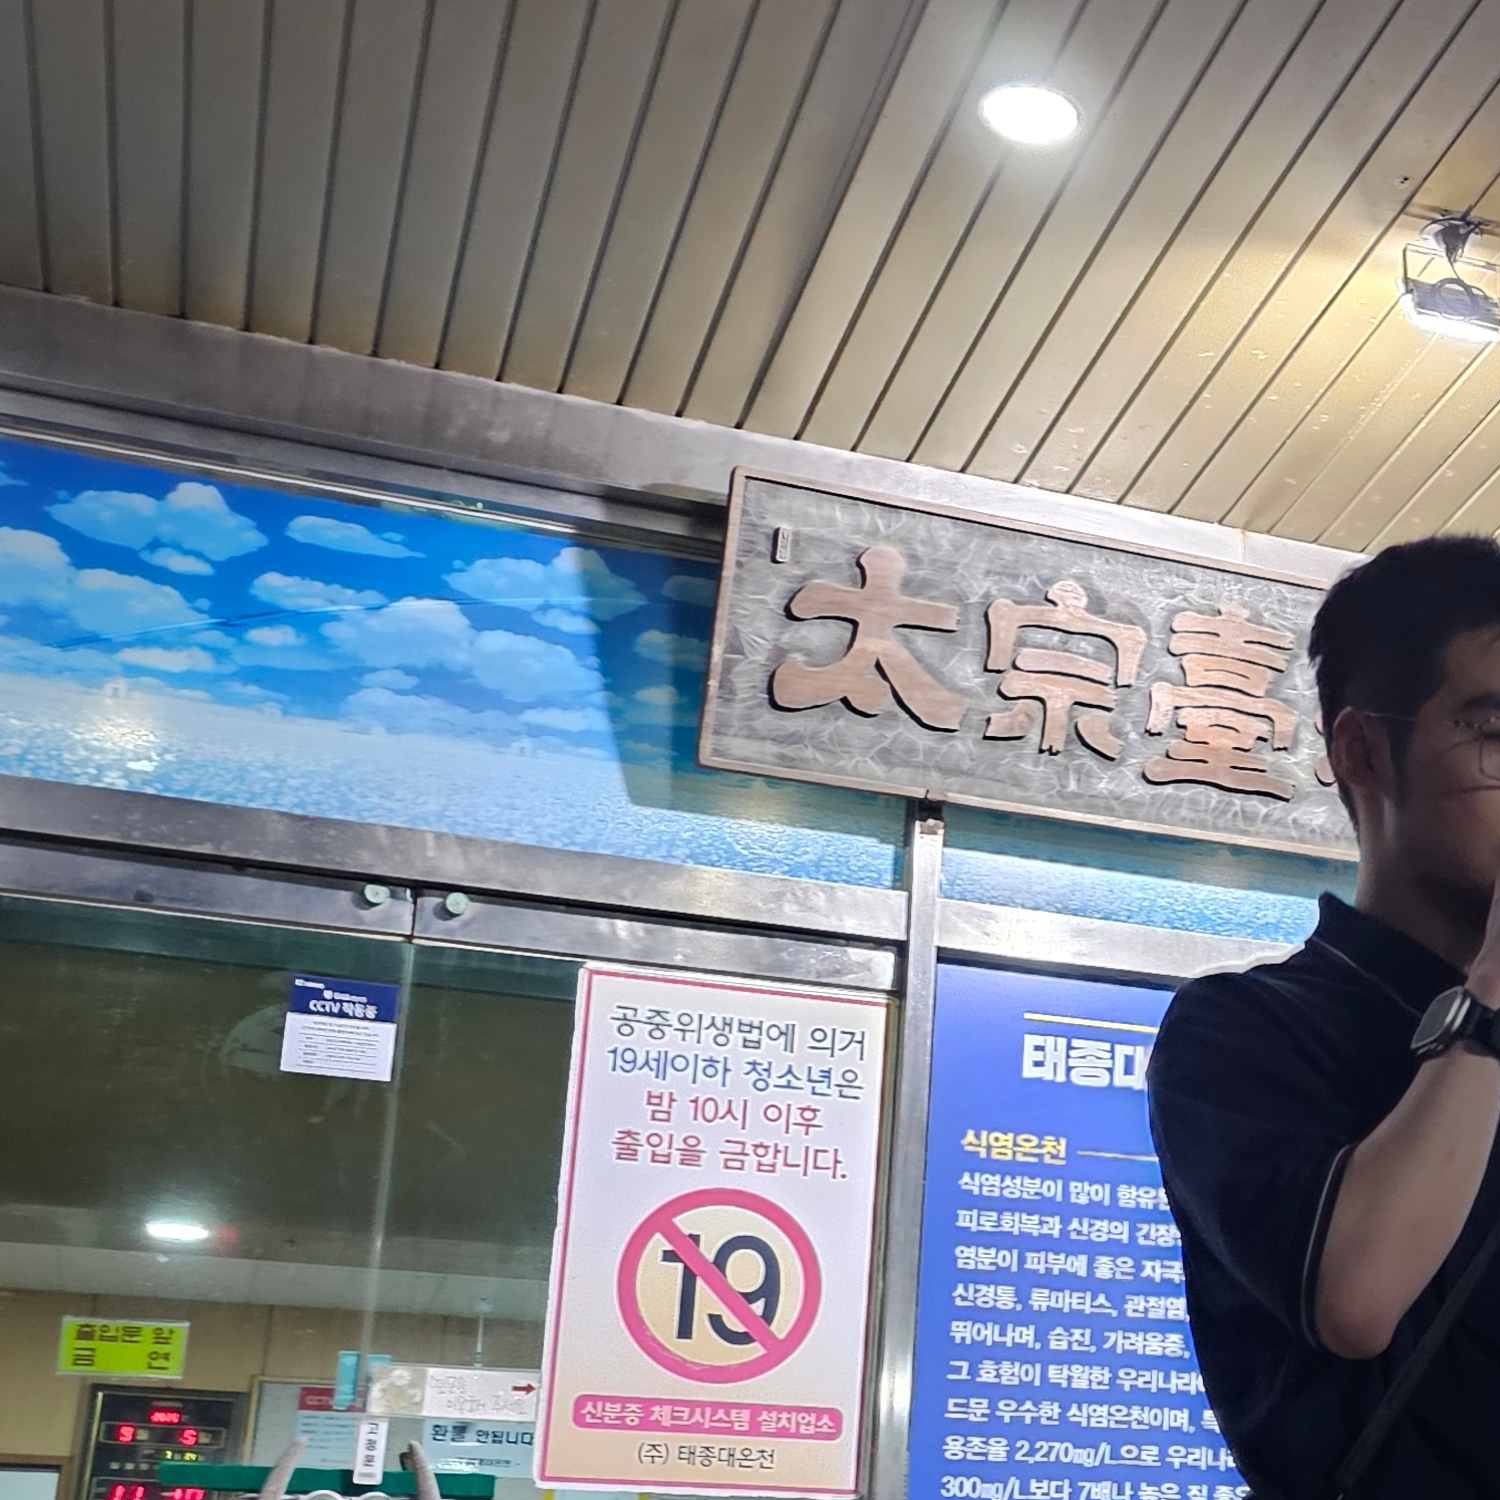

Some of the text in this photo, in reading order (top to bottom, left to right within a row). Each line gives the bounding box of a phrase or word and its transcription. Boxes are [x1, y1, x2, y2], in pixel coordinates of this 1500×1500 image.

[769, 547, 1337, 801] 太宗臺
[309, 1000, 341, 1014] CCTV
[609, 1005, 866, 1061] 공중위생법에 의거
[607, 1046, 865, 1100] 19세이하 청소년은
[645, 1090, 823, 1135] 밤 10시 이후
[611, 1128, 848, 1180] 출입을 금합니다.
[960, 1129, 1067, 1165] 식염온천
[958, 1172, 1063, 1201] 식염성분이
[1069, 1181, 1110, 1206] 많이
[955, 1209, 1182, 1247] 피로회복과 신경의 간장
[955, 1246, 1186, 1284] 염분이 피부에 좋은 자극
[659, 1233, 781, 1346] 19
[952, 1283, 1022, 1311] 신경통,
[1028, 1288, 1118, 1317] 류마티스,
[152, 1327, 175, 1345] 앞
[950, 1320, 1190, 1359] 뛰어나며, 습진, 가려움증,
[946, 1361, 970, 1381] 그
[976, 1360, 1041, 1386] 효험이
[1048, 1364, 1112, 1390] 탁월한
[580, 1401, 837, 1434] 신분증 체크시스템 설치업소
[944, 1398, 991, 1422] 드문
[996, 1399, 1061, 1426] 우수한
[1066, 1403, 1195, 1433] 식염온천이며,
[431, 1424, 468, 1443] 환불
[942, 1435, 1009, 1461] 용존율
[637, 1443, 775, 1470] (주) 태종대온천
